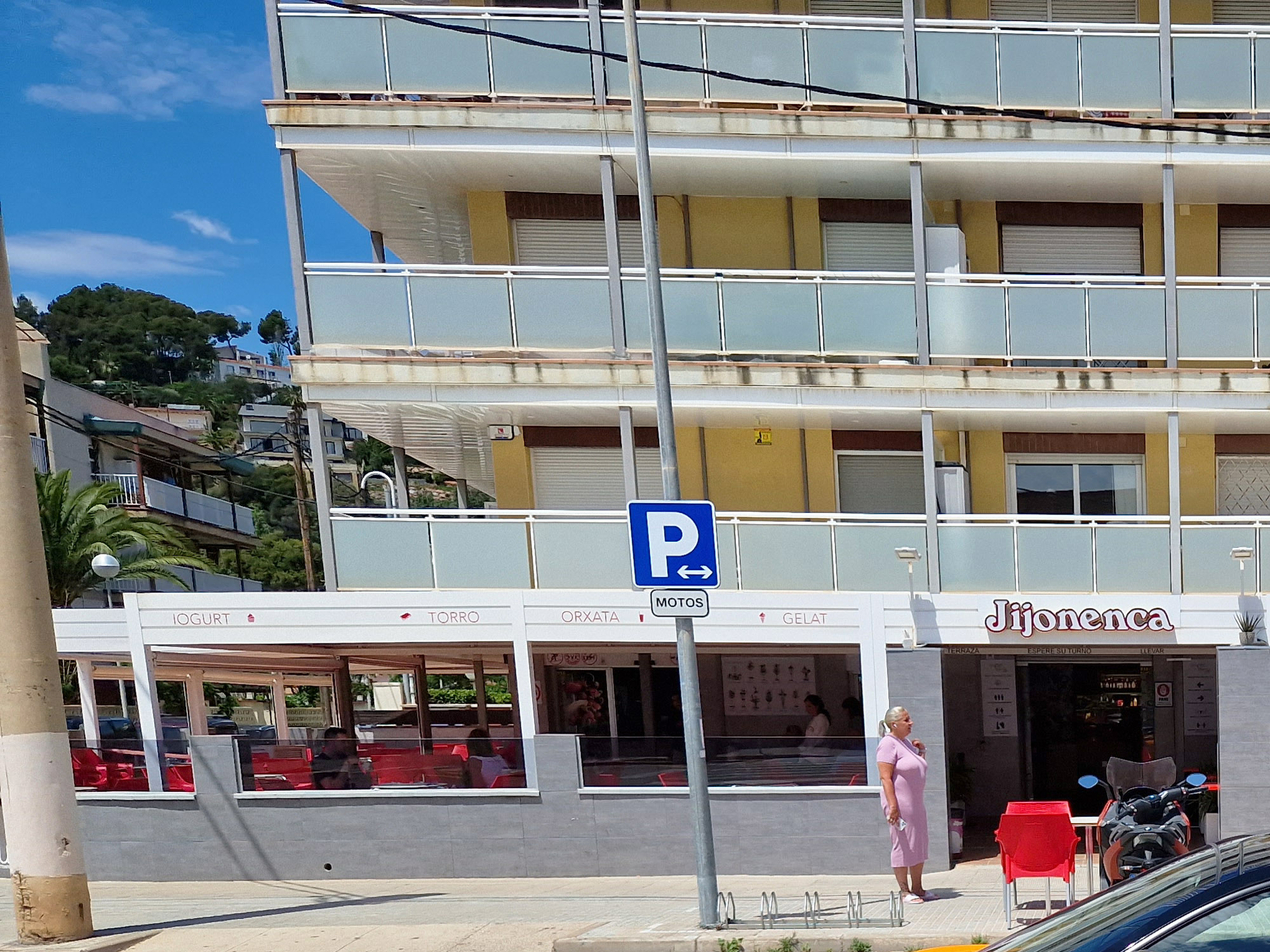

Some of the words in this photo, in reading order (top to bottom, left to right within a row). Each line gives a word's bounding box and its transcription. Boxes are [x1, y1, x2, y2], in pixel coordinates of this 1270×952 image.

[646, 511, 699, 578] P
[656, 597, 704, 608] MOTOS
[173, 612, 230, 625] IOGURT
[428, 611, 480, 624] TORRO
[561, 611, 620, 623] ORXATA
[783, 612, 827, 625] GELAT
[985, 599, 1175, 637] Jijonenca
